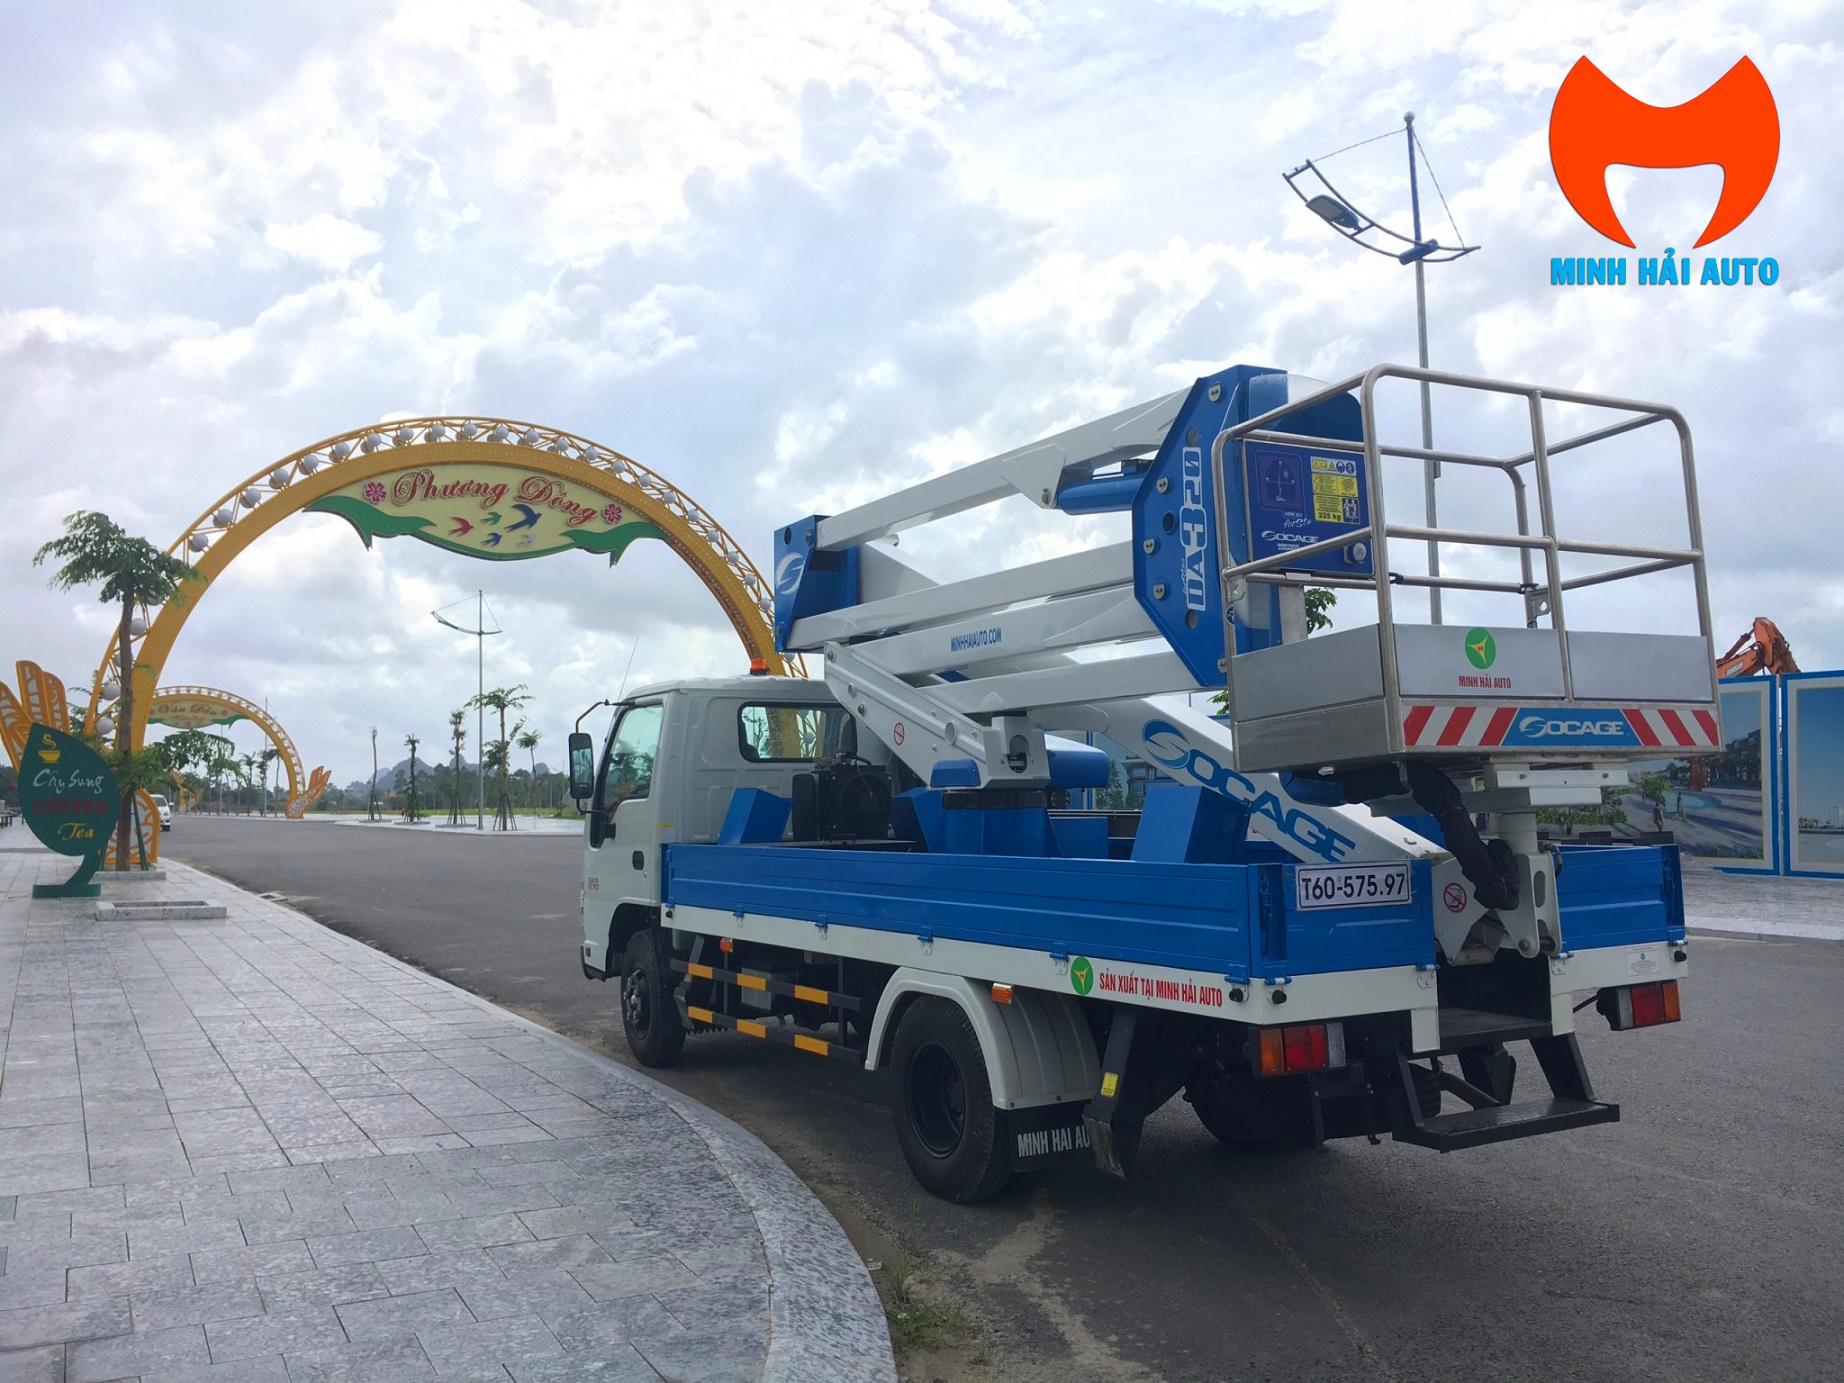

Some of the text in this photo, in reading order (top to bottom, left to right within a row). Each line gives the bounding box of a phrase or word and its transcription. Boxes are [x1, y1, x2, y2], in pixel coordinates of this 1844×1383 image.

[393, 468, 599, 526] Phương Đông
[1318, 511, 1342, 522] 225 kg
[1261, 530, 1319, 544] SOCAGE
[1458, 673, 1512, 689] MINH HẢI AUTO
[1519, 716, 1624, 738] SOCAGE
[1142, 719, 1356, 863] SOCAGE
[33, 797, 107, 815] COFFEE
[57, 822, 94, 840] Tea
[1302, 873, 1406, 901] T60-575.97
[1099, 967, 1223, 1007] SẢN XUẤT TẠI MINH HẢI AUTO
[1017, 1125, 1091, 1157] MINH HAI AU
